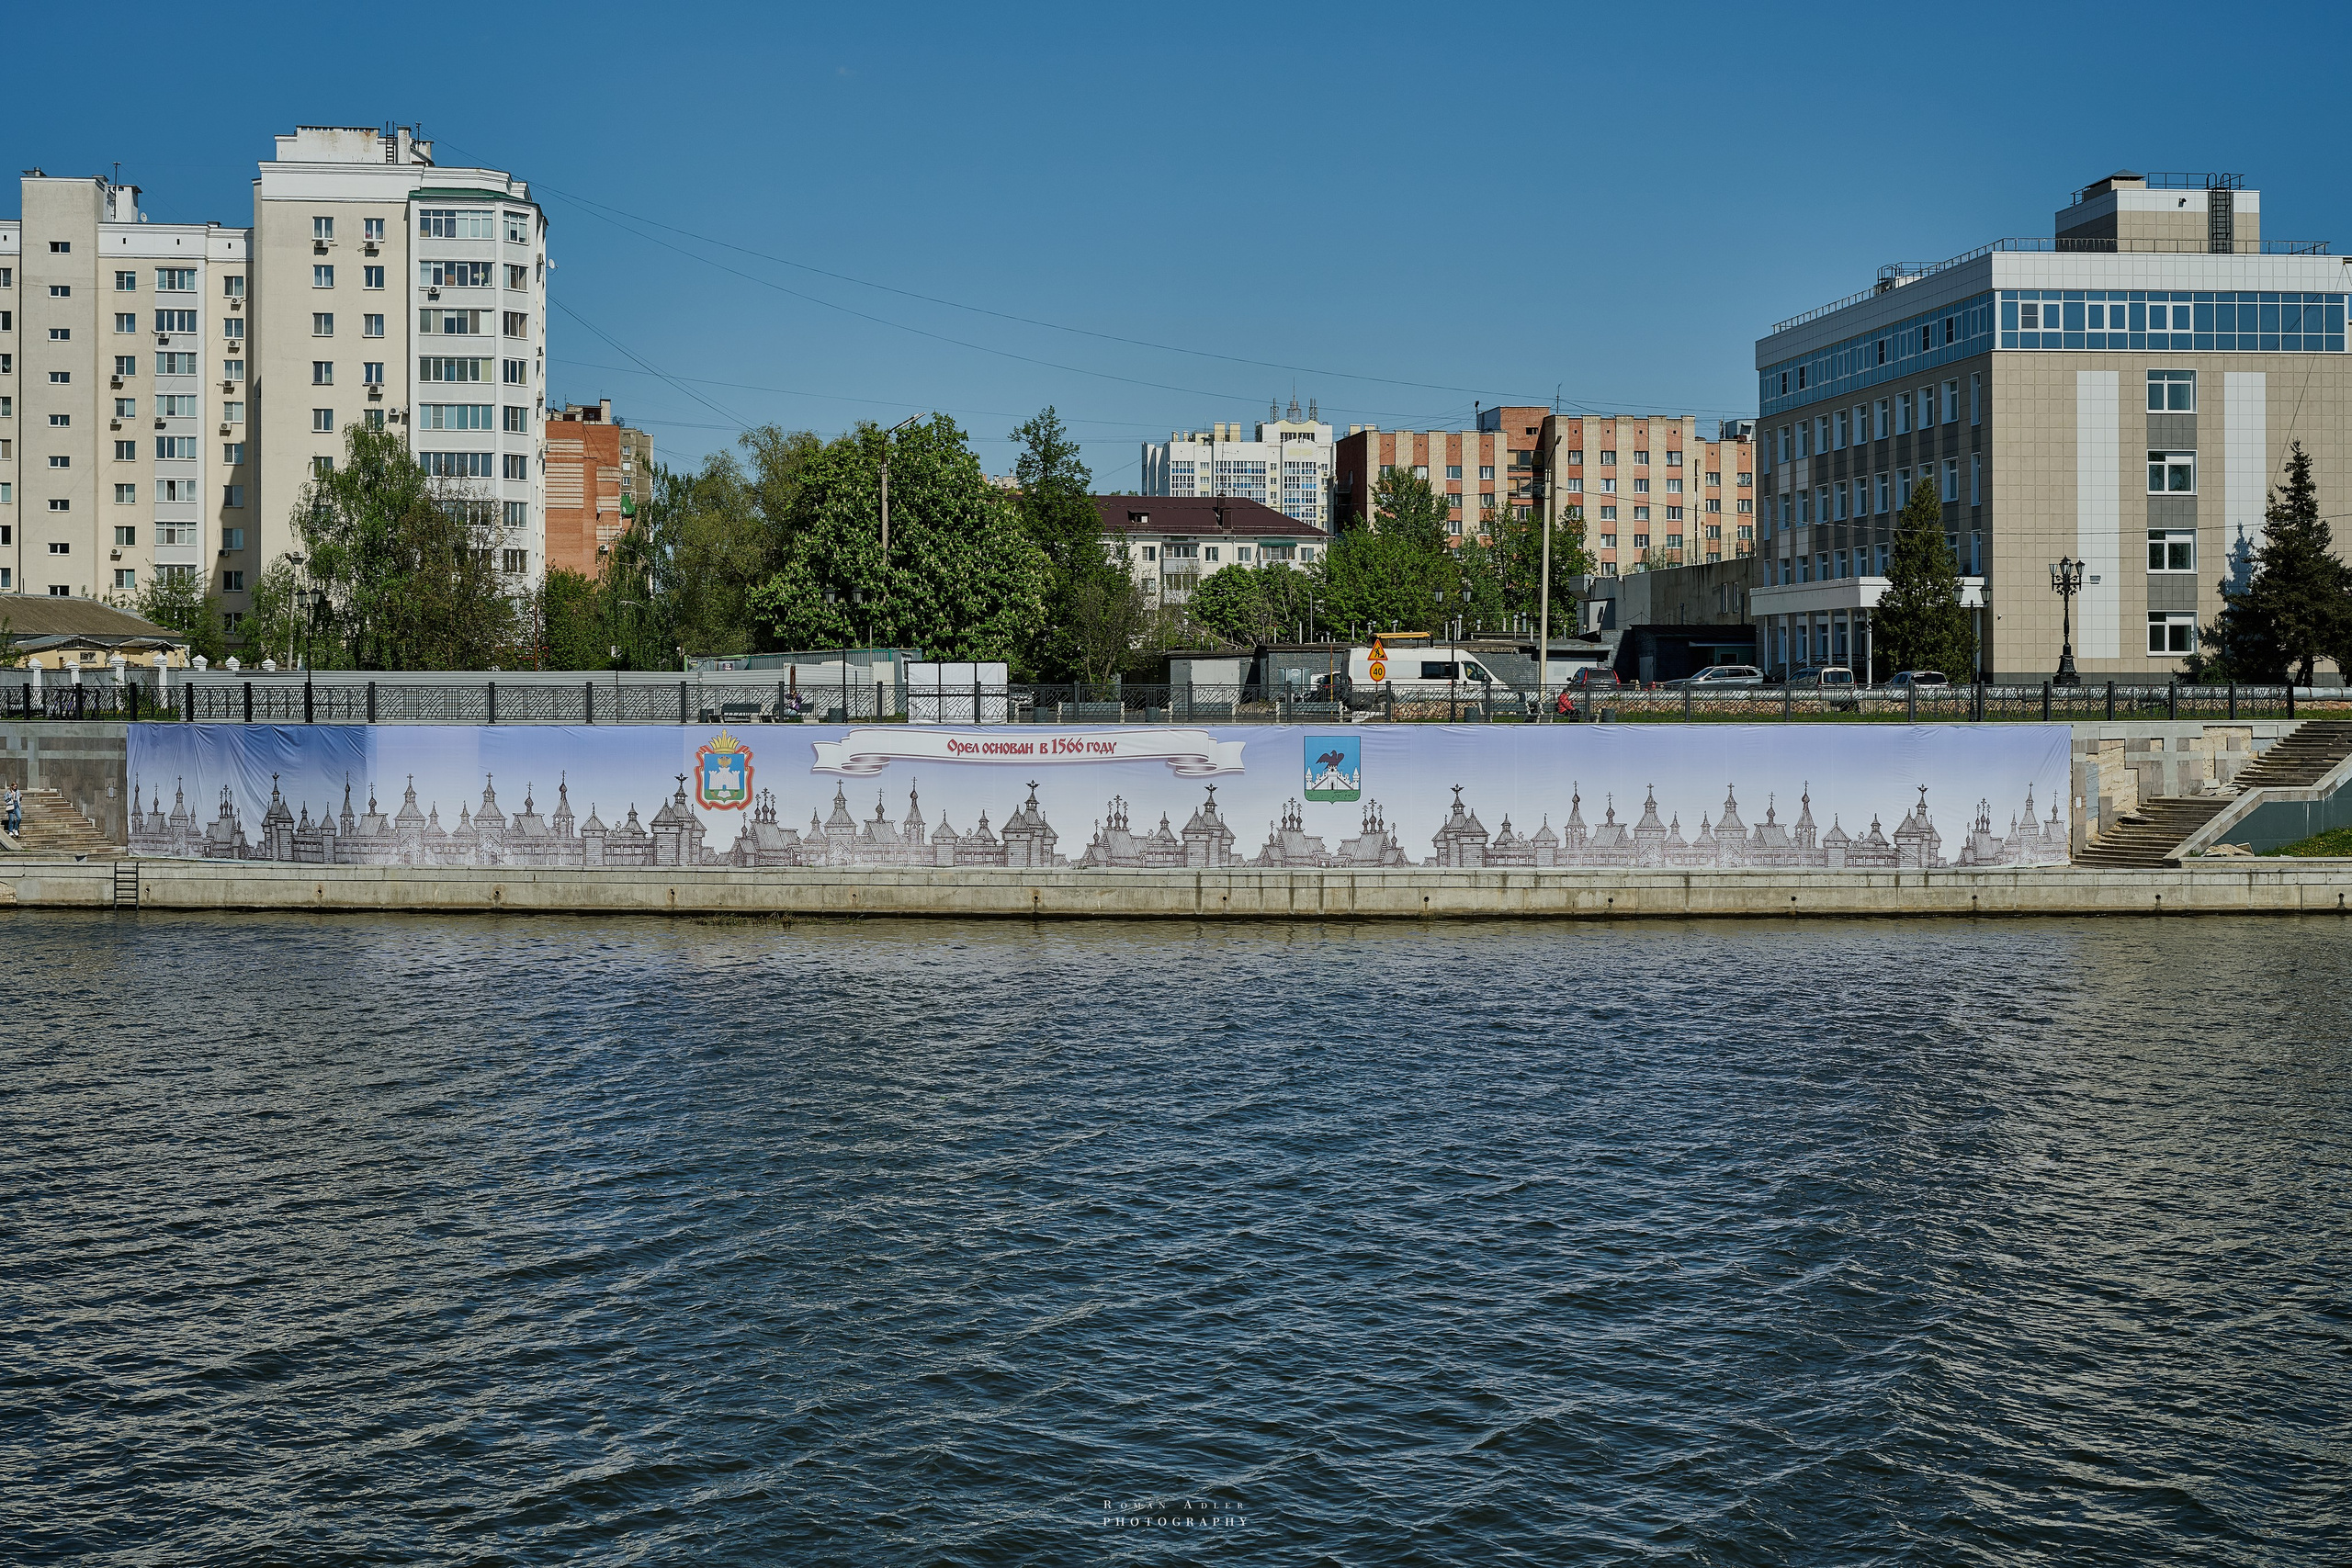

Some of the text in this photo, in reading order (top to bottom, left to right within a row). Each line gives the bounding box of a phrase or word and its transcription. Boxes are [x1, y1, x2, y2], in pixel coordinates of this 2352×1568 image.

[1373, 667, 1383, 676] 40
[982, 742, 1034, 754] основан
[1039, 742, 1048, 754] в
[1051, 738, 1084, 754] 1566
[1086, 741, 1117, 754] году
